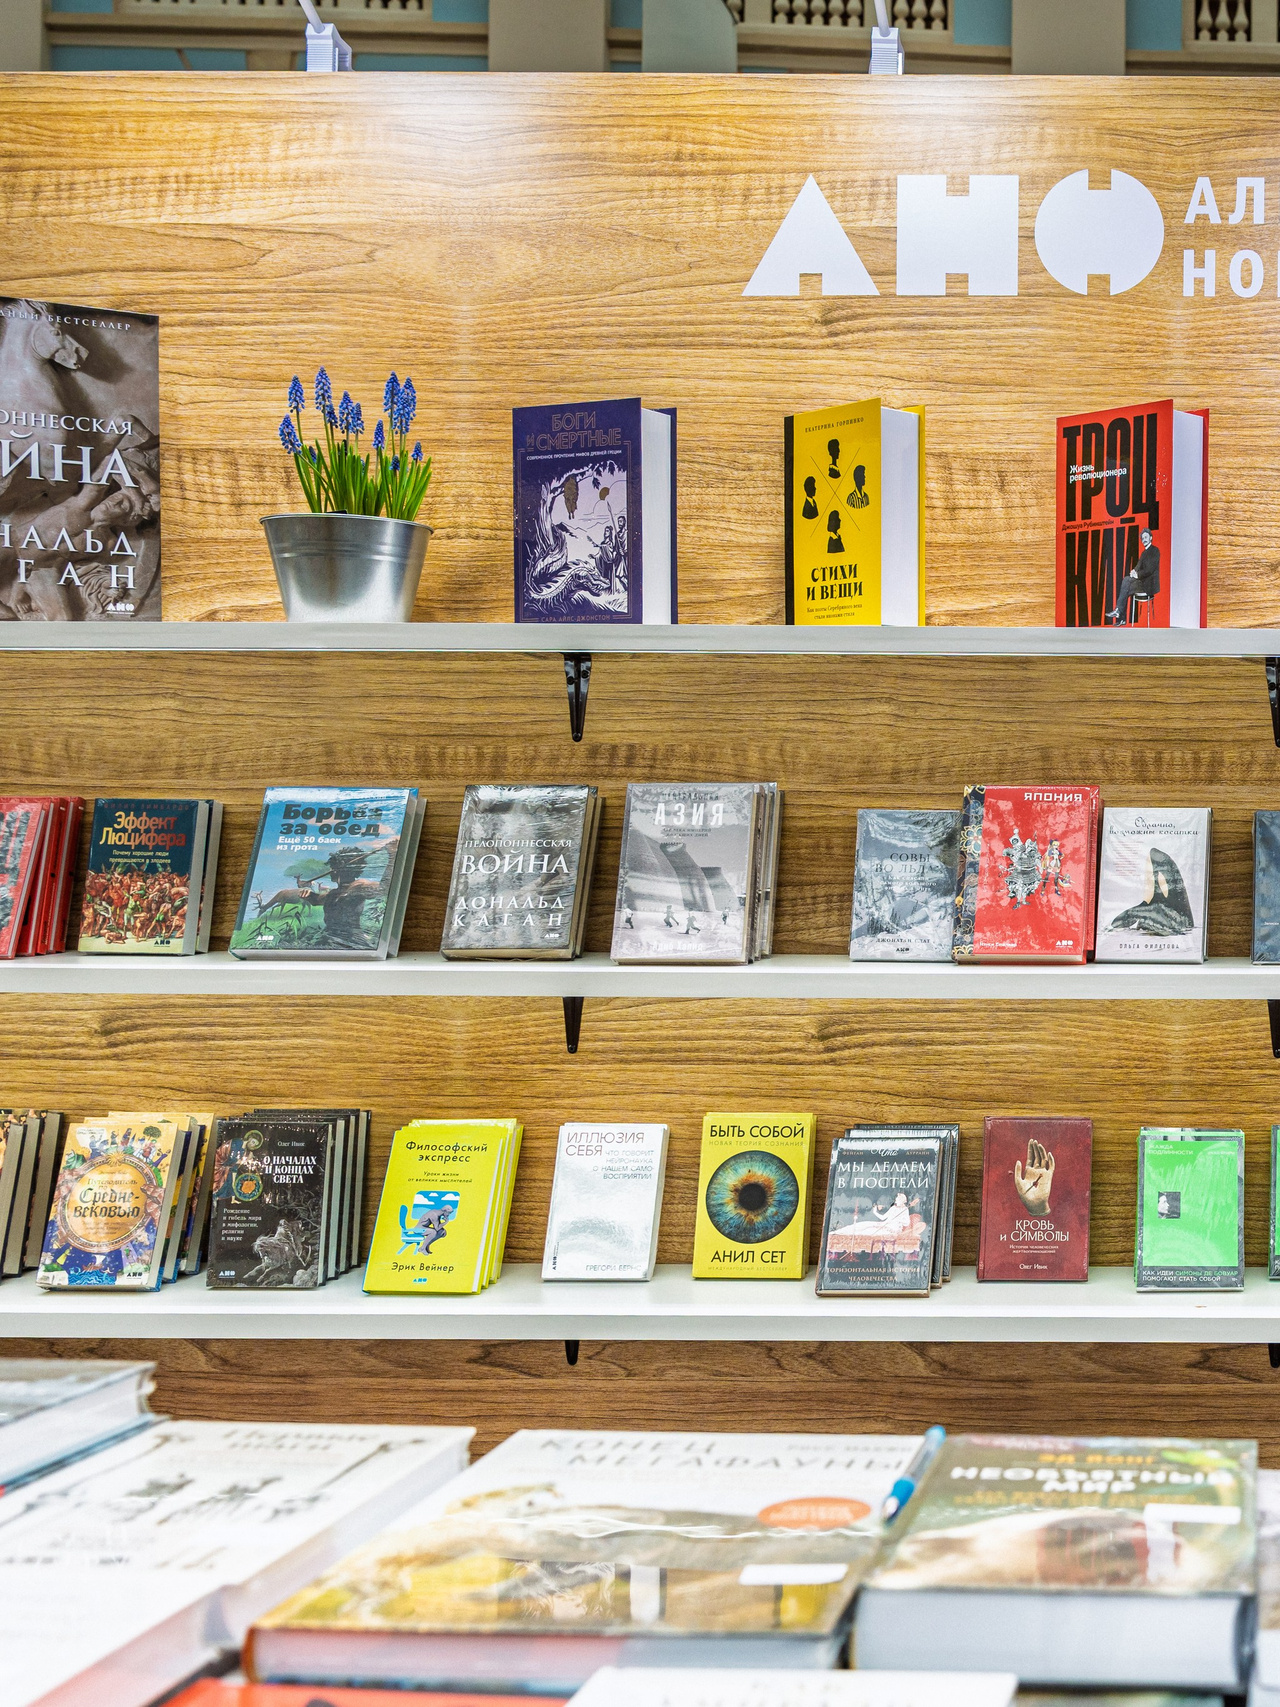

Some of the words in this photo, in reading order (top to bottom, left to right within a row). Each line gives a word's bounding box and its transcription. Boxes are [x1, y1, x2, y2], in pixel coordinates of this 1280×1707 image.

[48, 314, 132, 331] БЕСТСЕЛЛЕР
[552, 411, 596, 431] БОГИ
[536, 428, 621, 450] СМЕРТНЫЕ
[1070, 464, 1095, 474] Жизнь
[1070, 467, 1127, 483] революционера
[1062, 523, 1083, 531] Джошуа
[1084, 519, 1114, 528] Рубинштейн
[17, 558, 137, 590] ГАН
[811, 564, 857, 582] СТИХИ
[806, 587, 815, 601] И
[820, 582, 863, 600] ВЕЩИ
[1024, 792, 1083, 802] ЯПОНИЯ
[654, 802, 724, 826] АЗИЯ
[113, 811, 178, 833] Эффект
[279, 823, 308, 835] за
[318, 821, 380, 838] обед
[99, 827, 186, 850] Люцифера
[302, 836, 315, 844] 50
[317, 836, 342, 844] баек
[465, 839, 572, 848] ПЕЛОПОННЕССКАЯ
[290, 845, 318, 853] грота
[460, 849, 570, 874] ВОЙНА
[890, 852, 930, 863] СОВЫ
[875, 863, 894, 873] ВО
[455, 896, 565, 910] ДОНАЛЬД
[453, 913, 563, 927] КАГАН
[709, 1124, 746, 1138] БЫТЬ
[750, 1122, 805, 1138] СОБОЙ
[566, 1131, 645, 1144] ИЛЛЮЗИЯ
[405, 1140, 488, 1154] Философский
[565, 1144, 603, 1156] СЕБЯ
[263, 1156, 271, 1165] О
[272, 1156, 317, 1165] НАЧАЛАХ
[418, 1153, 471, 1164] экспресс
[274, 1165, 314, 1175] КОНЦАХ
[837, 1161, 865, 1172] МЫ
[870, 1161, 932, 1173] ДЕЛАЕМ
[273, 1175, 304, 1184] СВЕТА
[837, 1177, 846, 1189] В
[852, 1177, 929, 1189] ПОСТЕЛИ
[73, 1205, 141, 1218] вековью
[1015, 1219, 1054, 1231] КРОВЬ
[1010, 1230, 1070, 1242] СИМВОЛЫ
[711, 1250, 756, 1263] АНИЛ
[760, 1250, 787, 1264] СЕТ
[391, 1261, 416, 1273] Эрик
[420, 1261, 455, 1274] Вейнер
[1019, 1263, 1033, 1271] Олег
[1042, 1479, 1137, 1494] МИР
